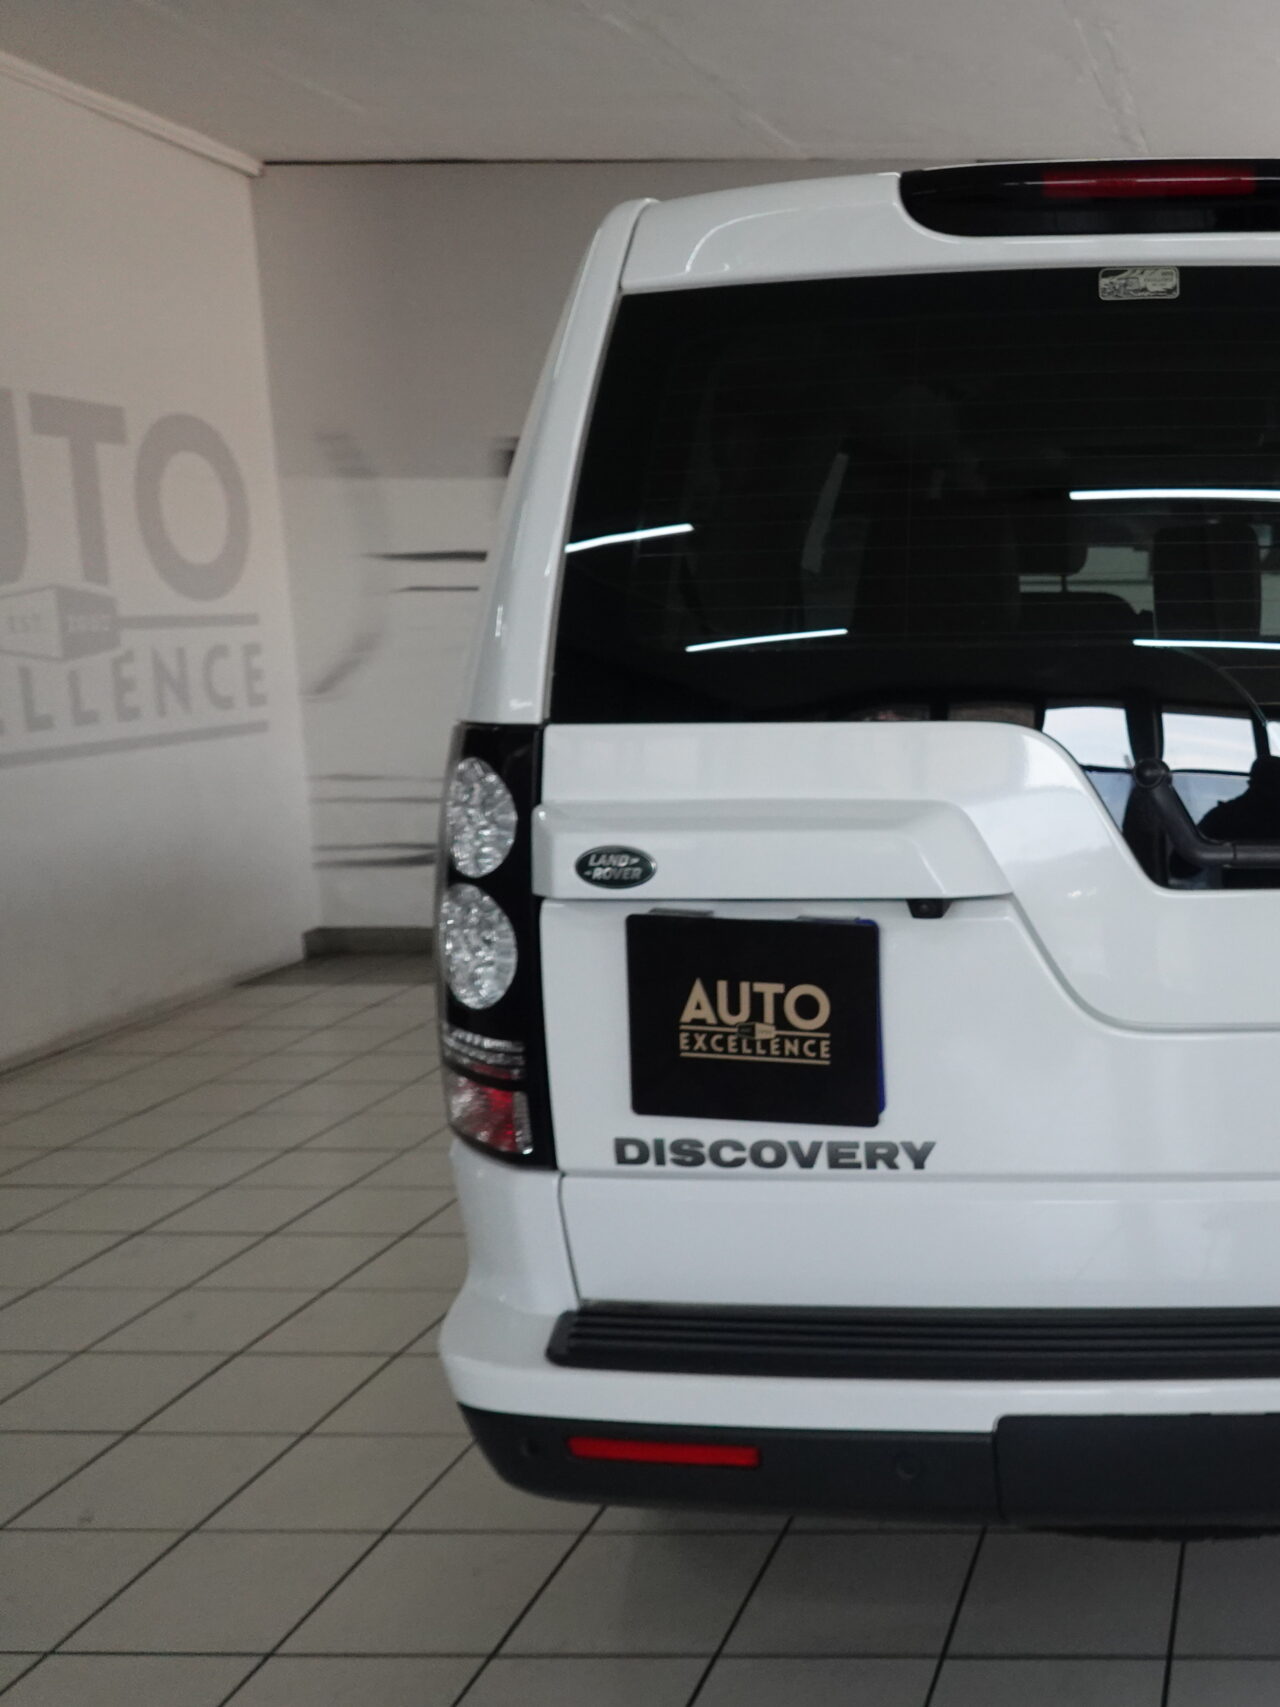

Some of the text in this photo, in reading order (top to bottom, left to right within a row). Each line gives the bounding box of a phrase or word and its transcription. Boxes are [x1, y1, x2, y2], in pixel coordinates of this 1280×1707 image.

[0, 386, 250, 601] TO
[0, 642, 268, 736] LLENCE
[588, 853, 630, 867] LAND
[591, 867, 643, 881] ROVER
[679, 977, 831, 1031] AUTO
[679, 1031, 831, 1059] EXCELLENCE
[613, 1137, 937, 1170] DISCOVERY
